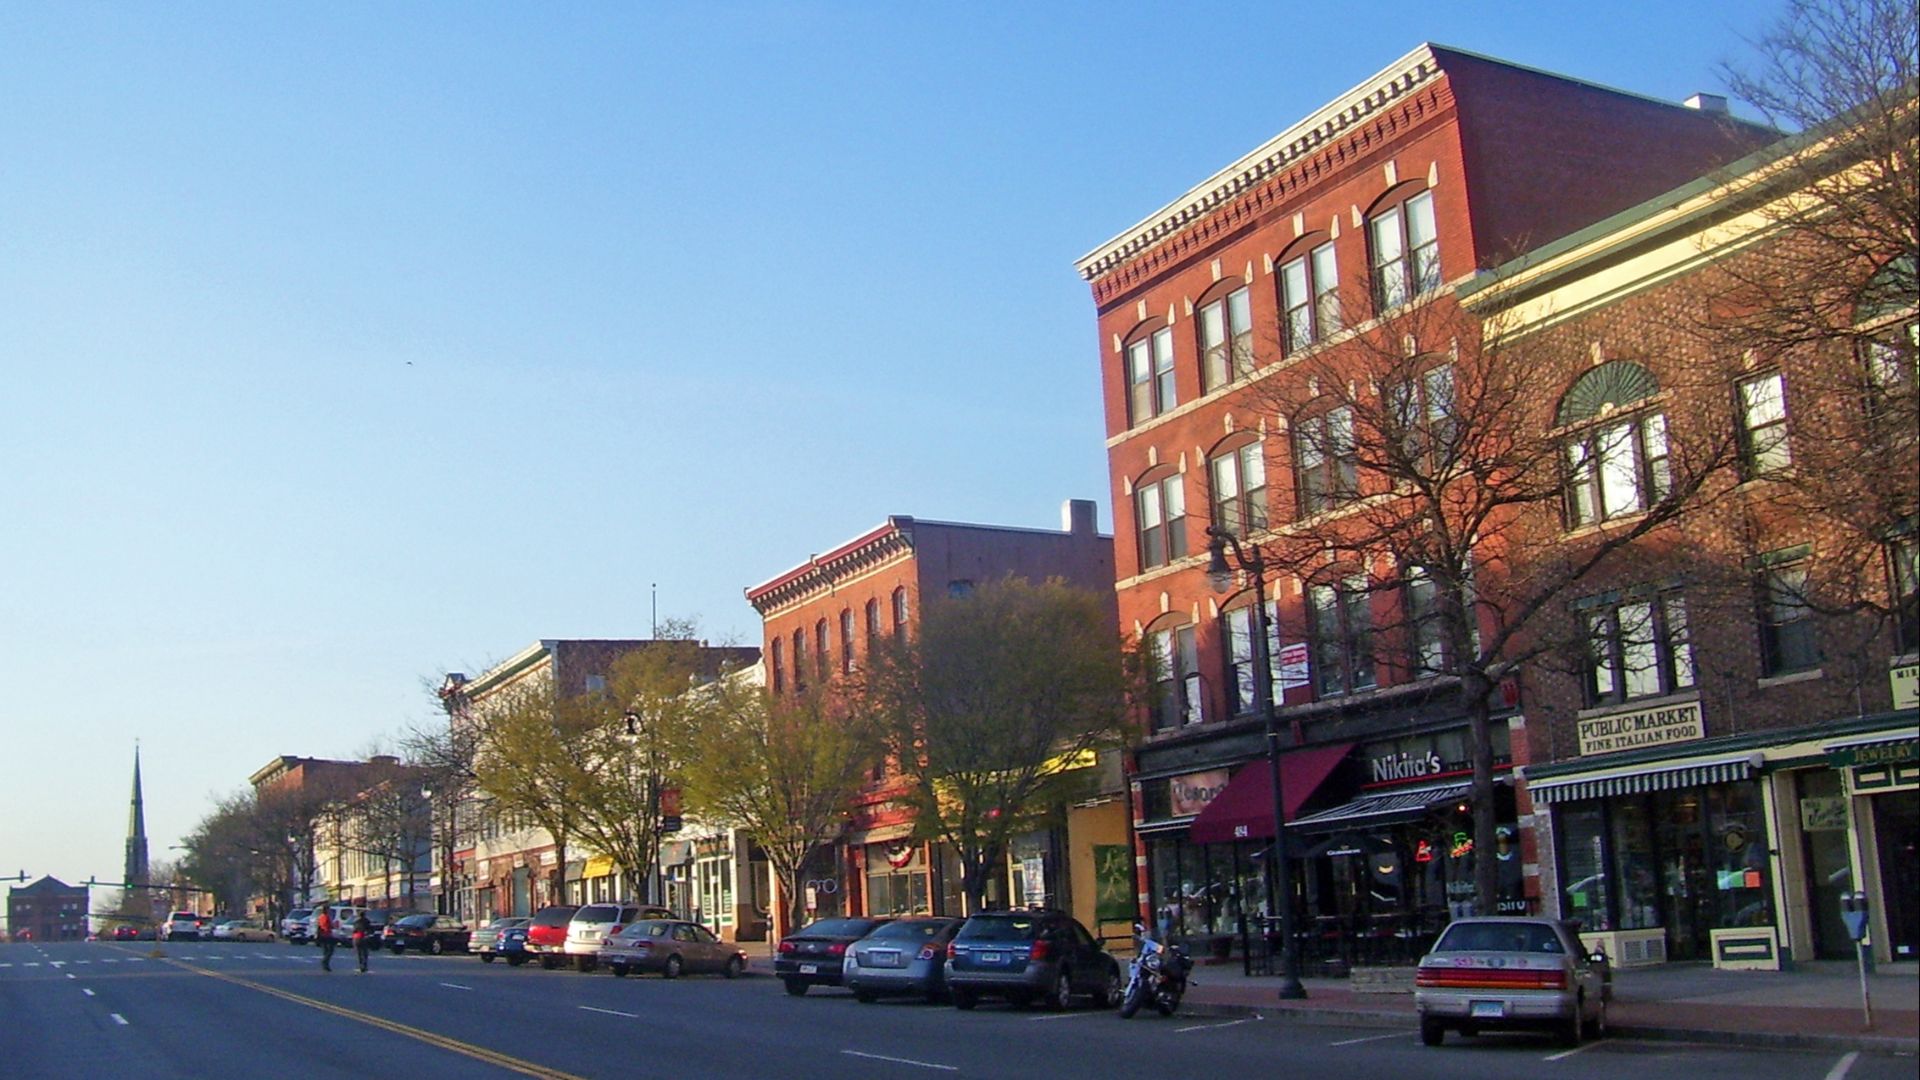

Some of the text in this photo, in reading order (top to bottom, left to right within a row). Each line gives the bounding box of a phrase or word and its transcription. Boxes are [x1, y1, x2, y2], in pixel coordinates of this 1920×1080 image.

[1581, 706, 1697, 739] PUBLIC MARKET
[1586, 725, 1697, 752] FINE ITALIAN FOOD
[1372, 751, 1440, 782] Nikita's
[1855, 745, 1912, 762] JEWELRY
